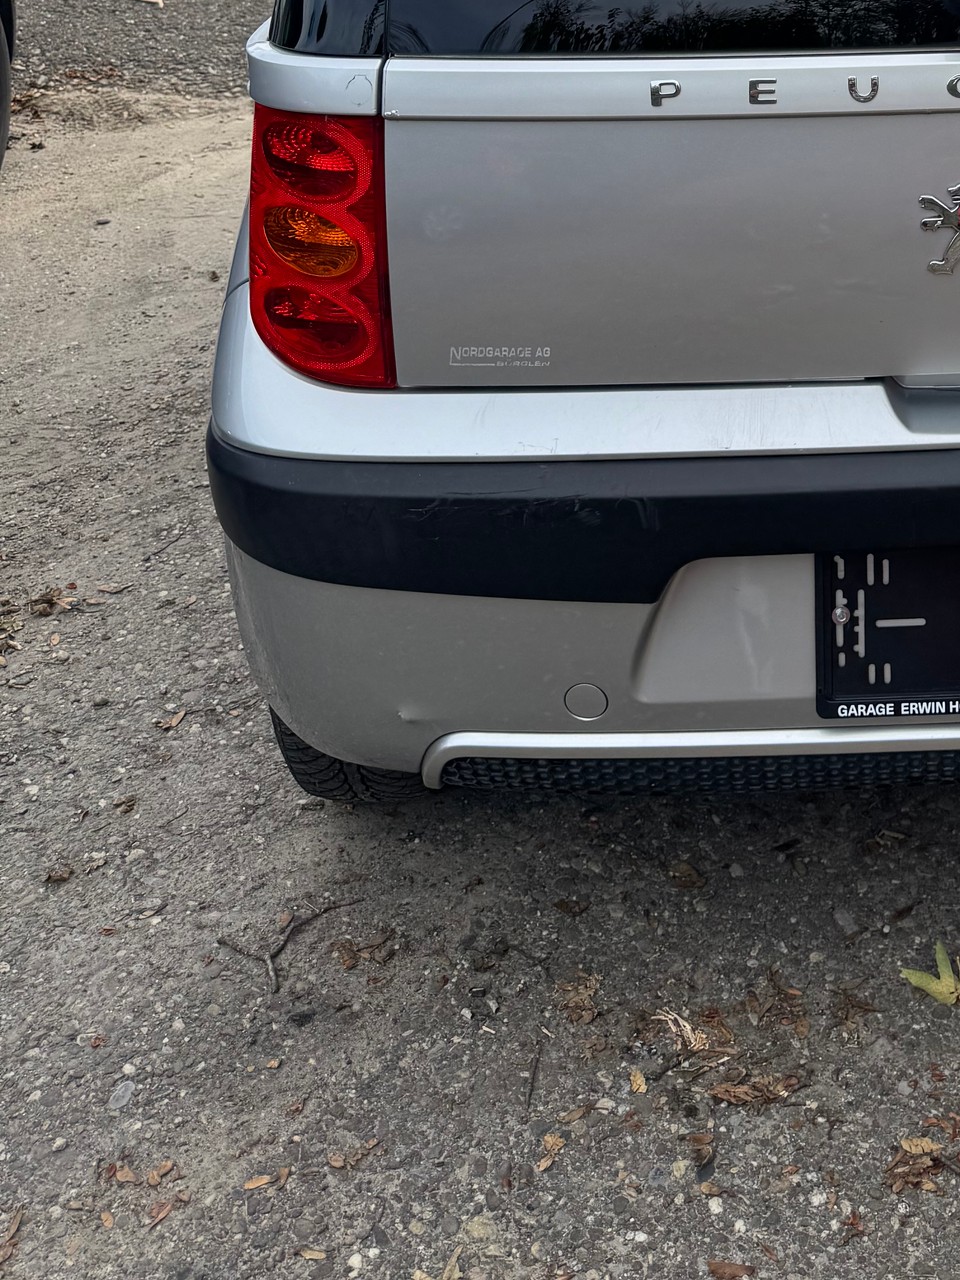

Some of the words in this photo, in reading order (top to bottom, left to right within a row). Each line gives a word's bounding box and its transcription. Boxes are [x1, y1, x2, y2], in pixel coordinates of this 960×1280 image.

[535, 346, 551, 358] AG
[837, 703, 895, 717] GARAGE
[900, 701, 946, 715] ERWIN
